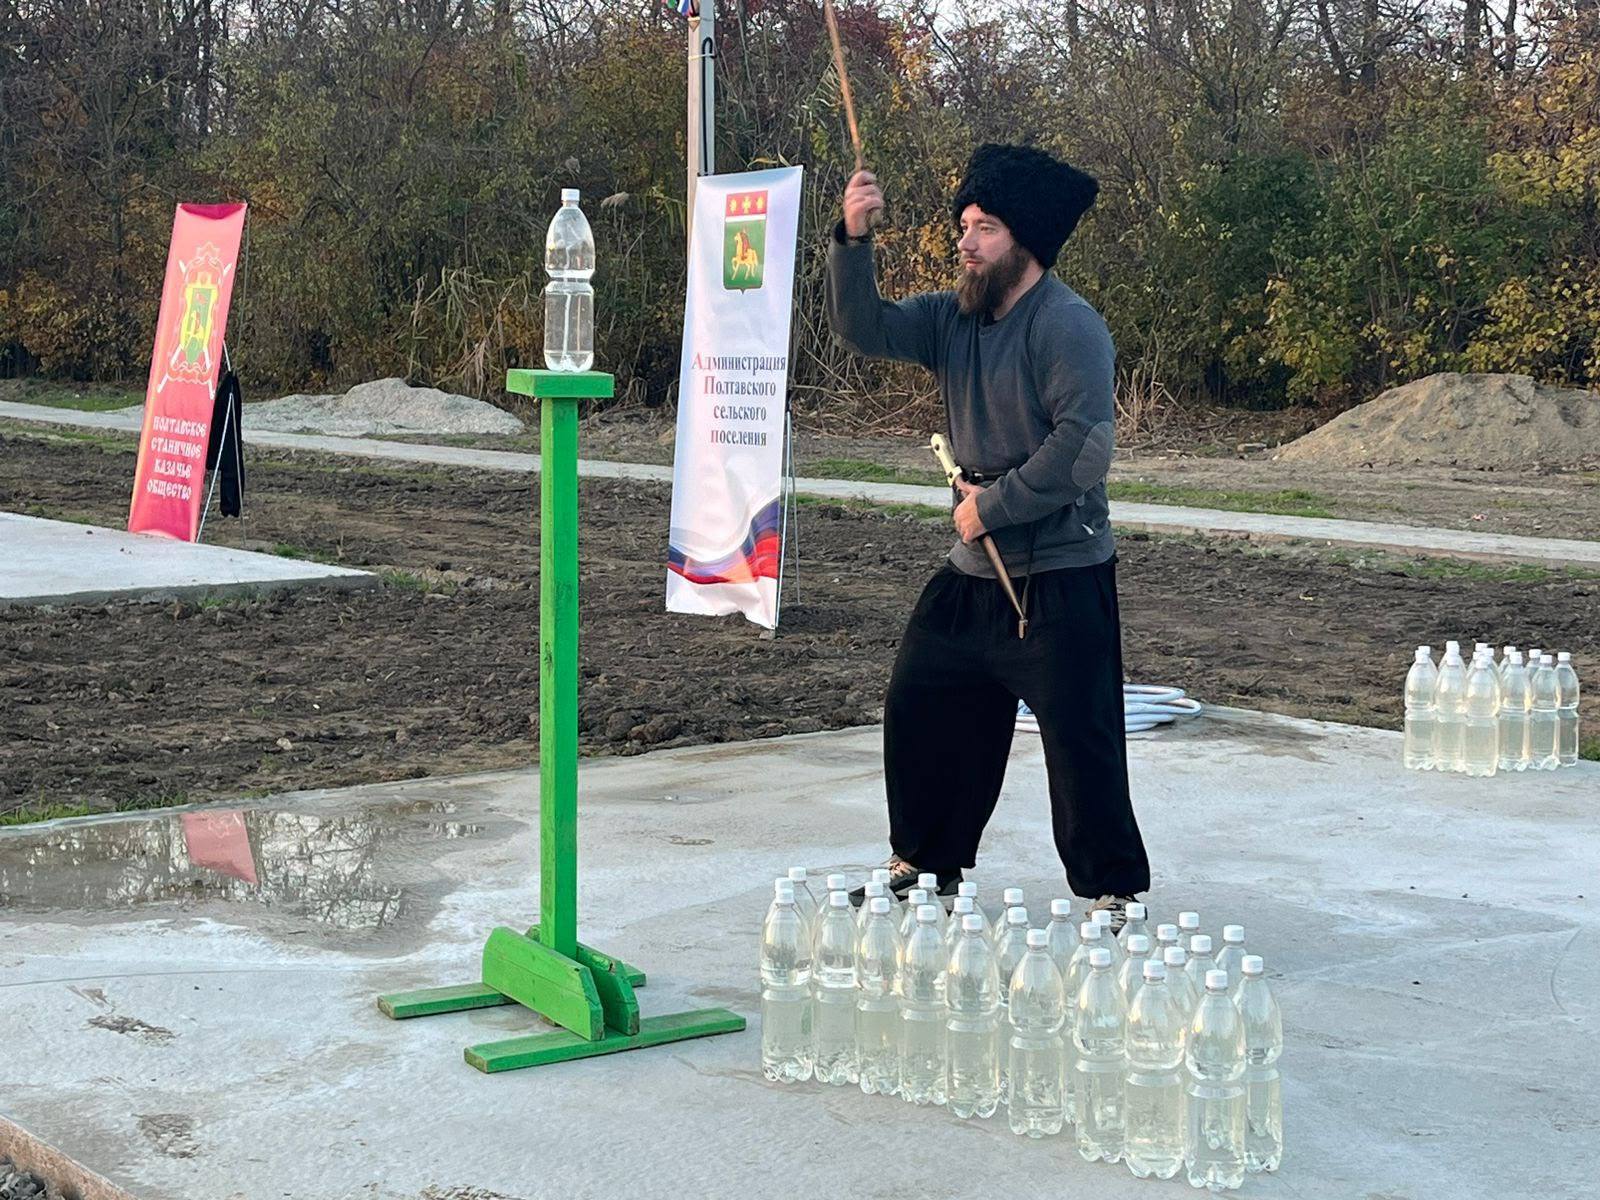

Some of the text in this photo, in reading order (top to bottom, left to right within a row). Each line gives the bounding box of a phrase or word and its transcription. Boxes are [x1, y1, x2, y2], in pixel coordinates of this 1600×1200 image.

[691, 352, 786, 376] Администрация
[703, 376, 776, 396] Полтавского
[713, 405, 767, 421] сельского
[153, 416, 207, 437] ПОЛТАВСКОЕ
[151, 437, 202, 459] СТАНИЧНОЕ
[711, 430, 767, 446] поселения
[154, 459, 192, 479] КАЗАЧЬЕ
[146, 479, 192, 500] ОБЩЕСТВО
